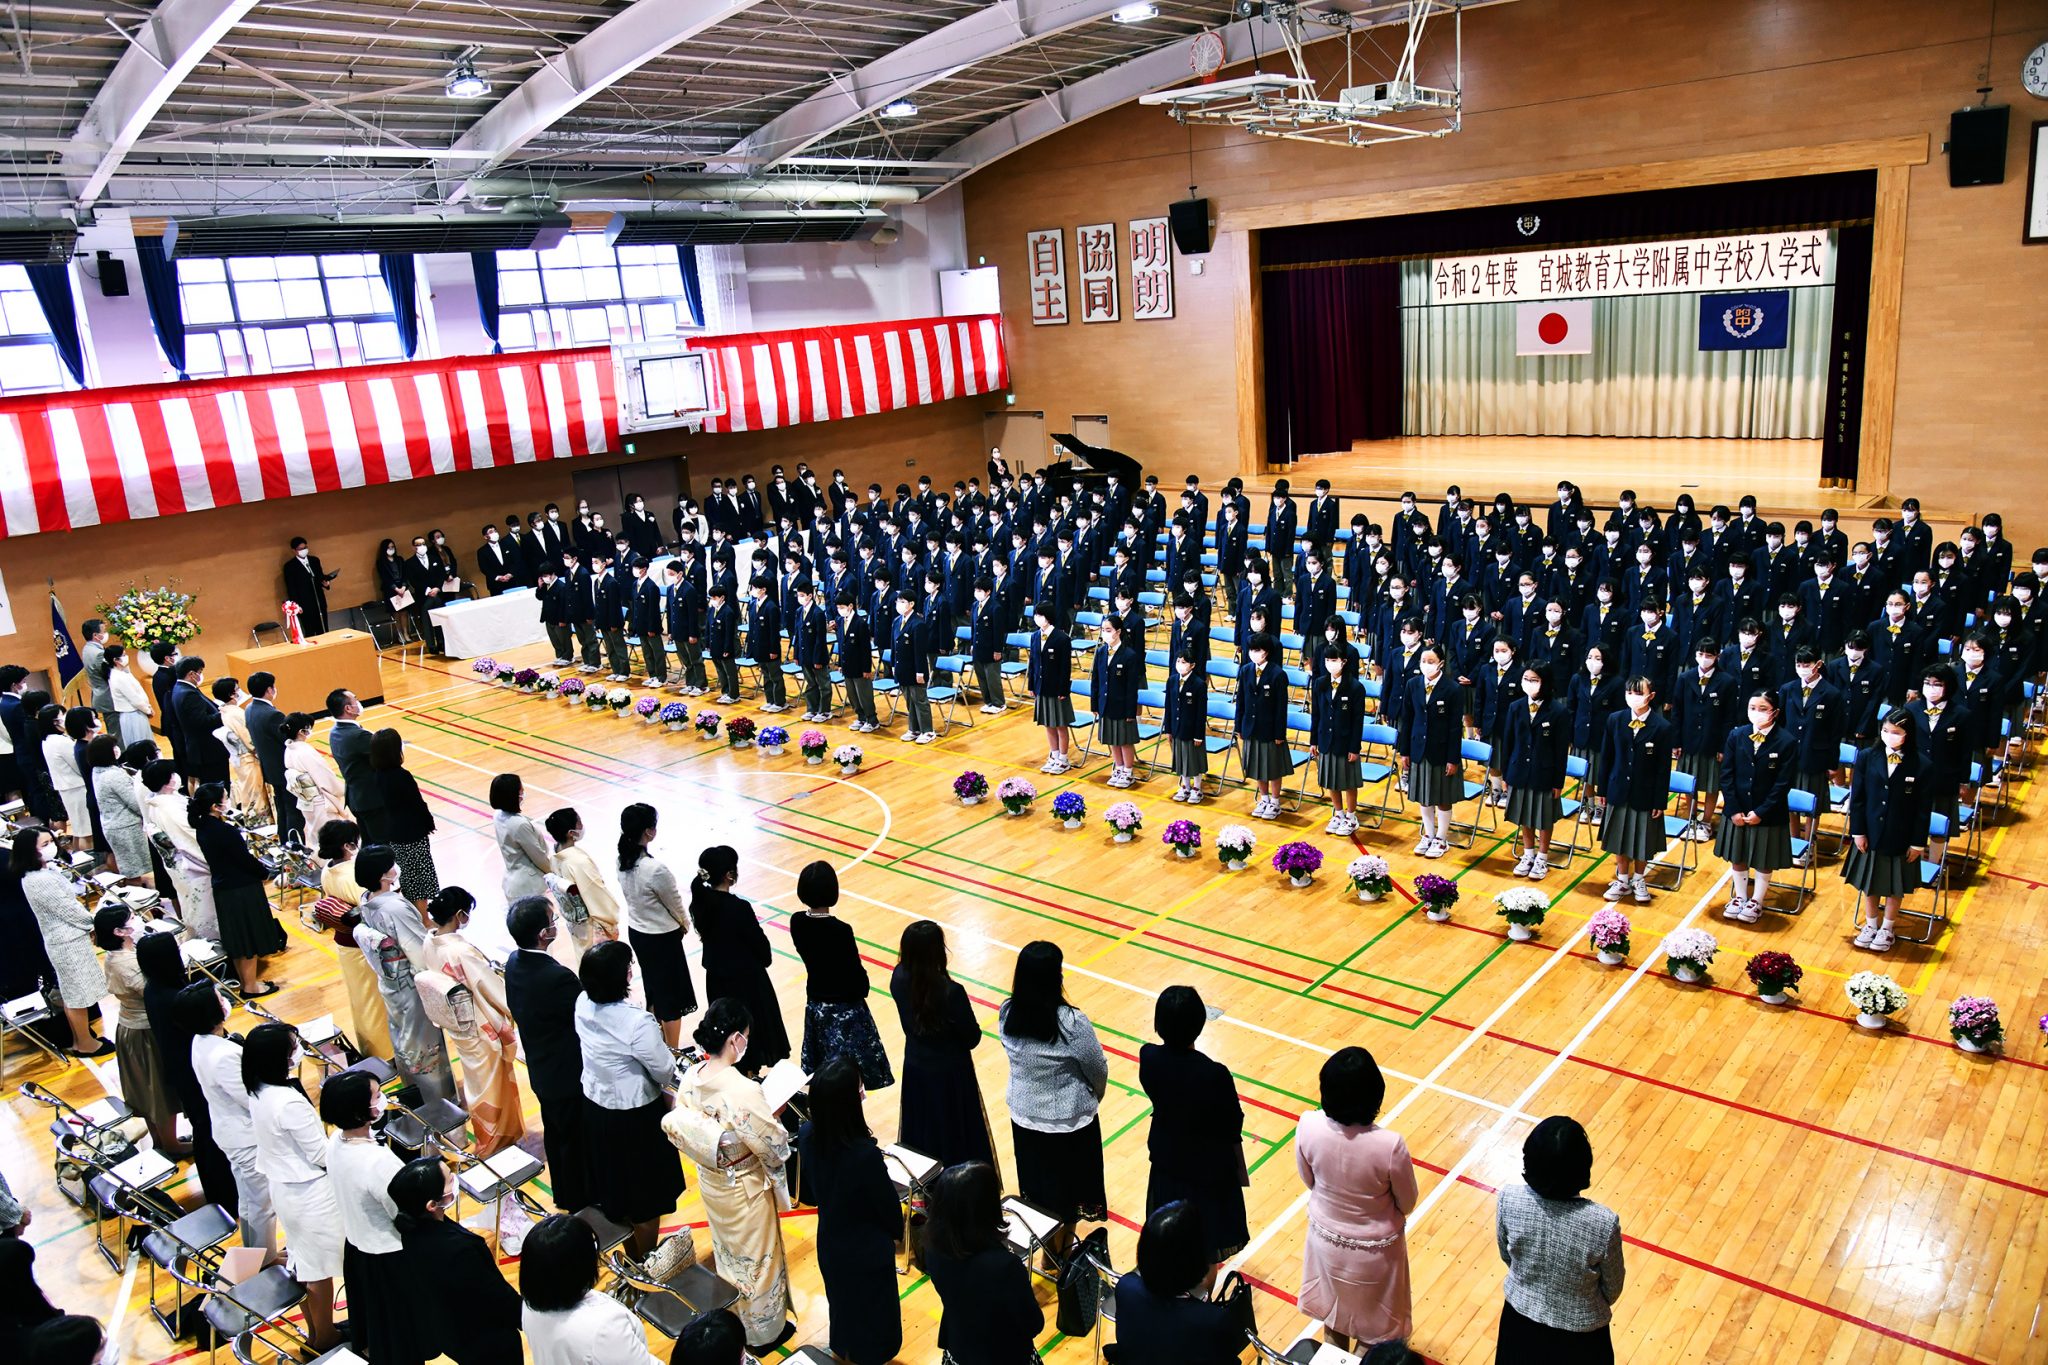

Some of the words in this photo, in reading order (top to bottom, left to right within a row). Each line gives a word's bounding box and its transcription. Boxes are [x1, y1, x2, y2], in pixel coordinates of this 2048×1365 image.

[2029, 67, 2037, 76] 9
[2030, 56, 2043, 66] 10
[2032, 75, 2040, 84] 8
[2041, 82, 2048, 91] 7
[1032, 234, 1065, 320] 自主
[1079, 229, 1114, 319] 協同
[1131, 222, 1170, 314] 明朗
[1434, 256, 1518, 300] 令和2年度
[1538, 234, 1822, 294] 宮城教育大学附属中学校入学式
